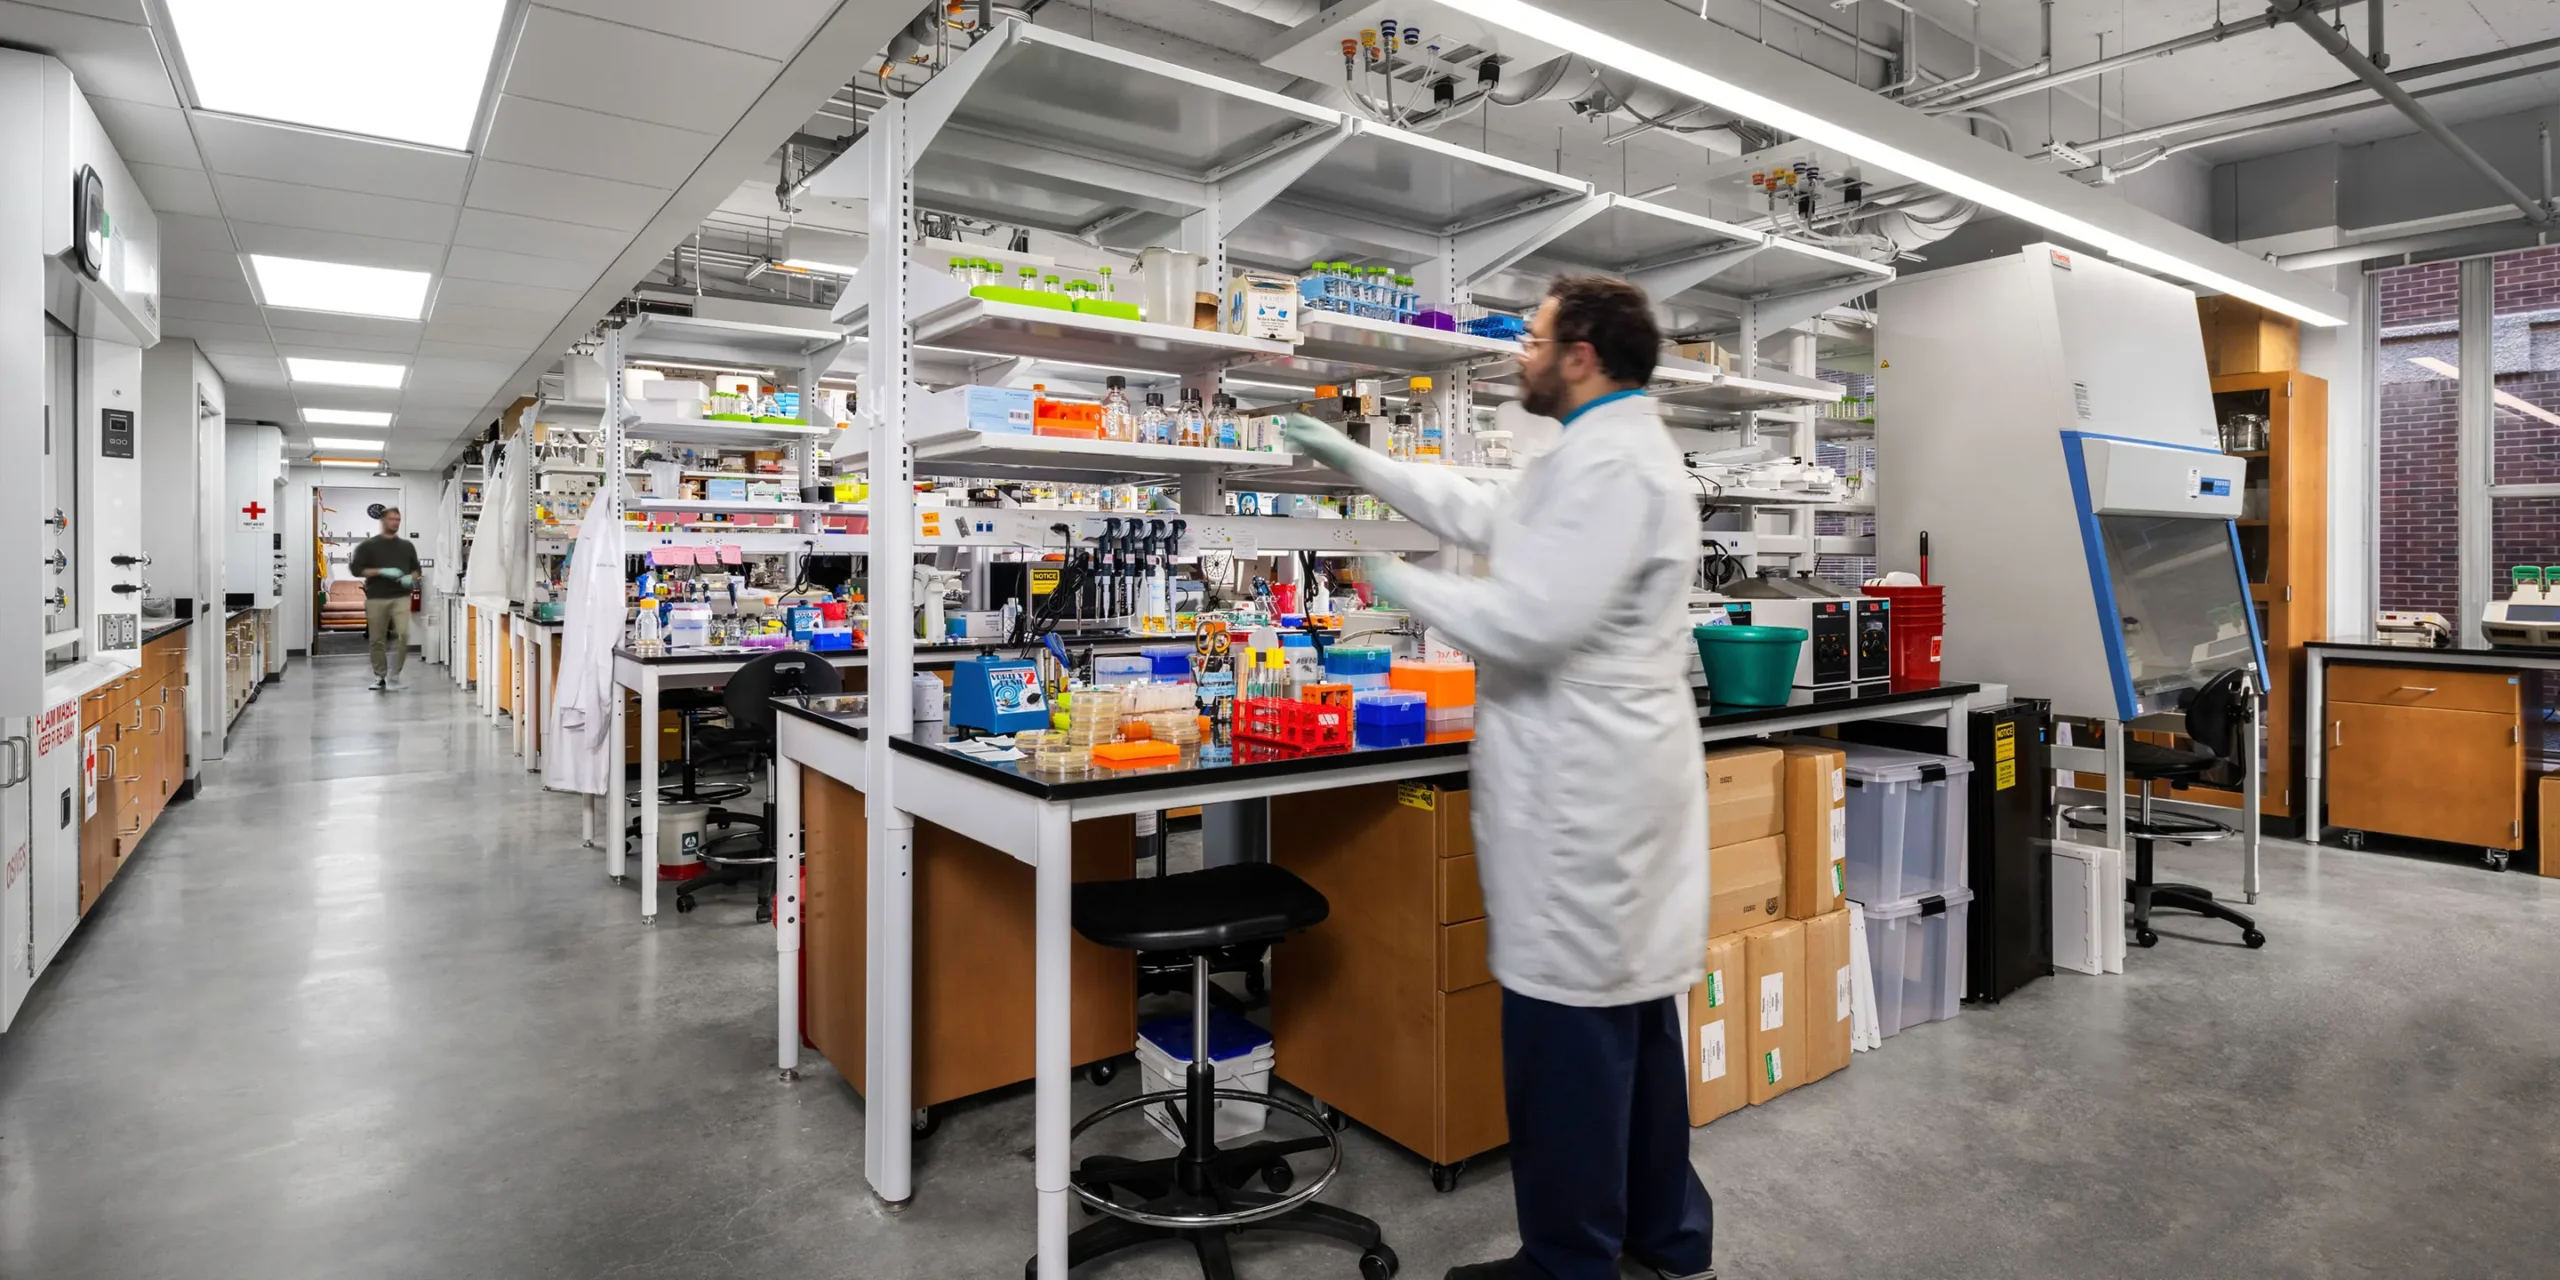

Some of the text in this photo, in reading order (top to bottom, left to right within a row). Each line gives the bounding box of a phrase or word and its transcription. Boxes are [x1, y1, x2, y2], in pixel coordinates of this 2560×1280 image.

[1024, 672, 1035, 684] 2
[36, 698, 77, 736] FLAMMABLE
[39, 721, 75, 758] KEEP FIRE AWAY
[1997, 727, 2013, 738] NOTICE
